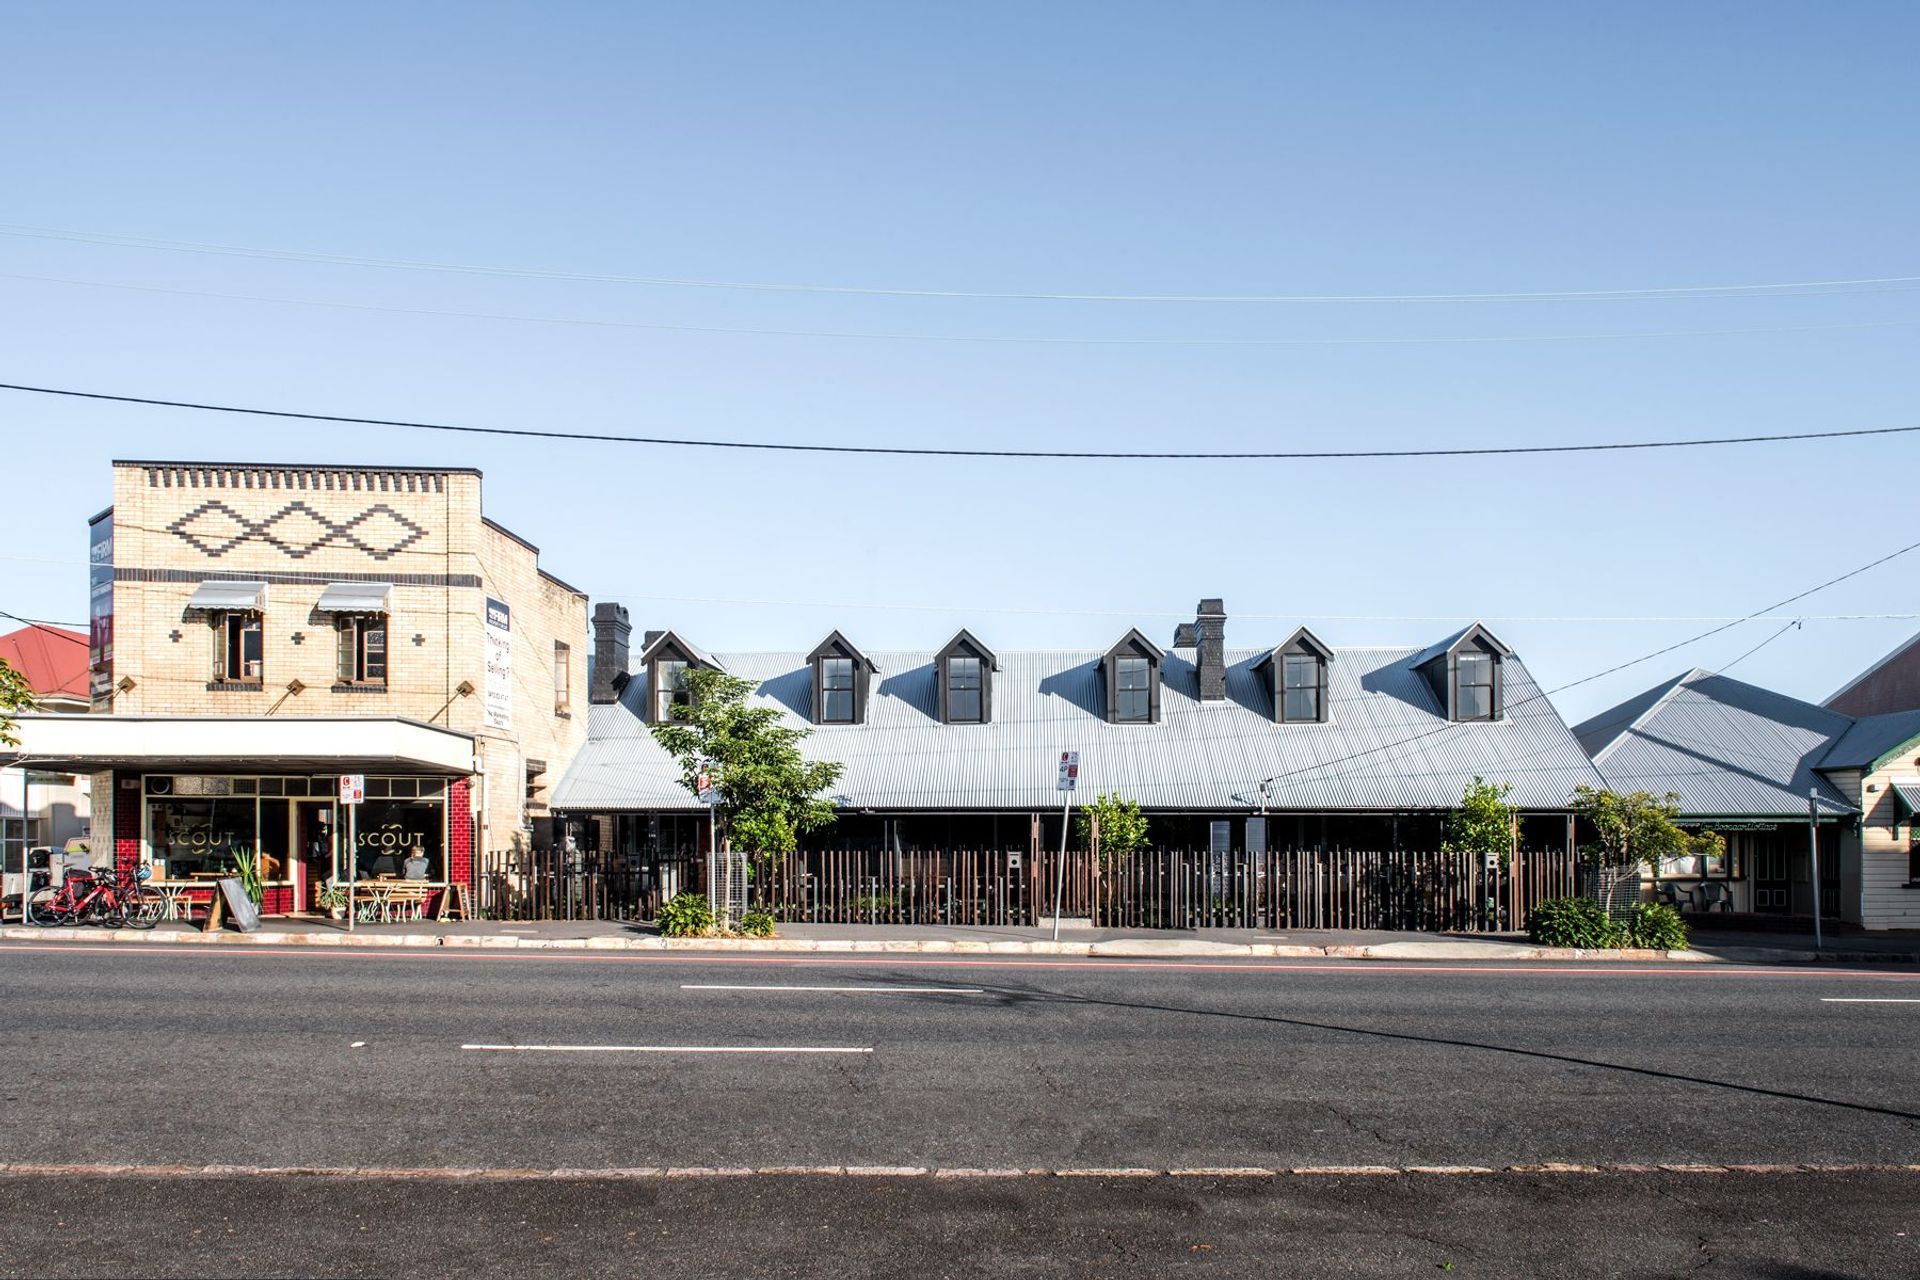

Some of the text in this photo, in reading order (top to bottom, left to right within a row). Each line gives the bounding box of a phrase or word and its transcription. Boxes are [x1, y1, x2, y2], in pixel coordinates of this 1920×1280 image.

[486, 632, 509, 654] Thinking
[495, 651, 502, 661] of
[487, 661, 510, 680] Selling?
[167, 831, 235, 846] SCOUT
[358, 832, 424, 847] SCOUT
